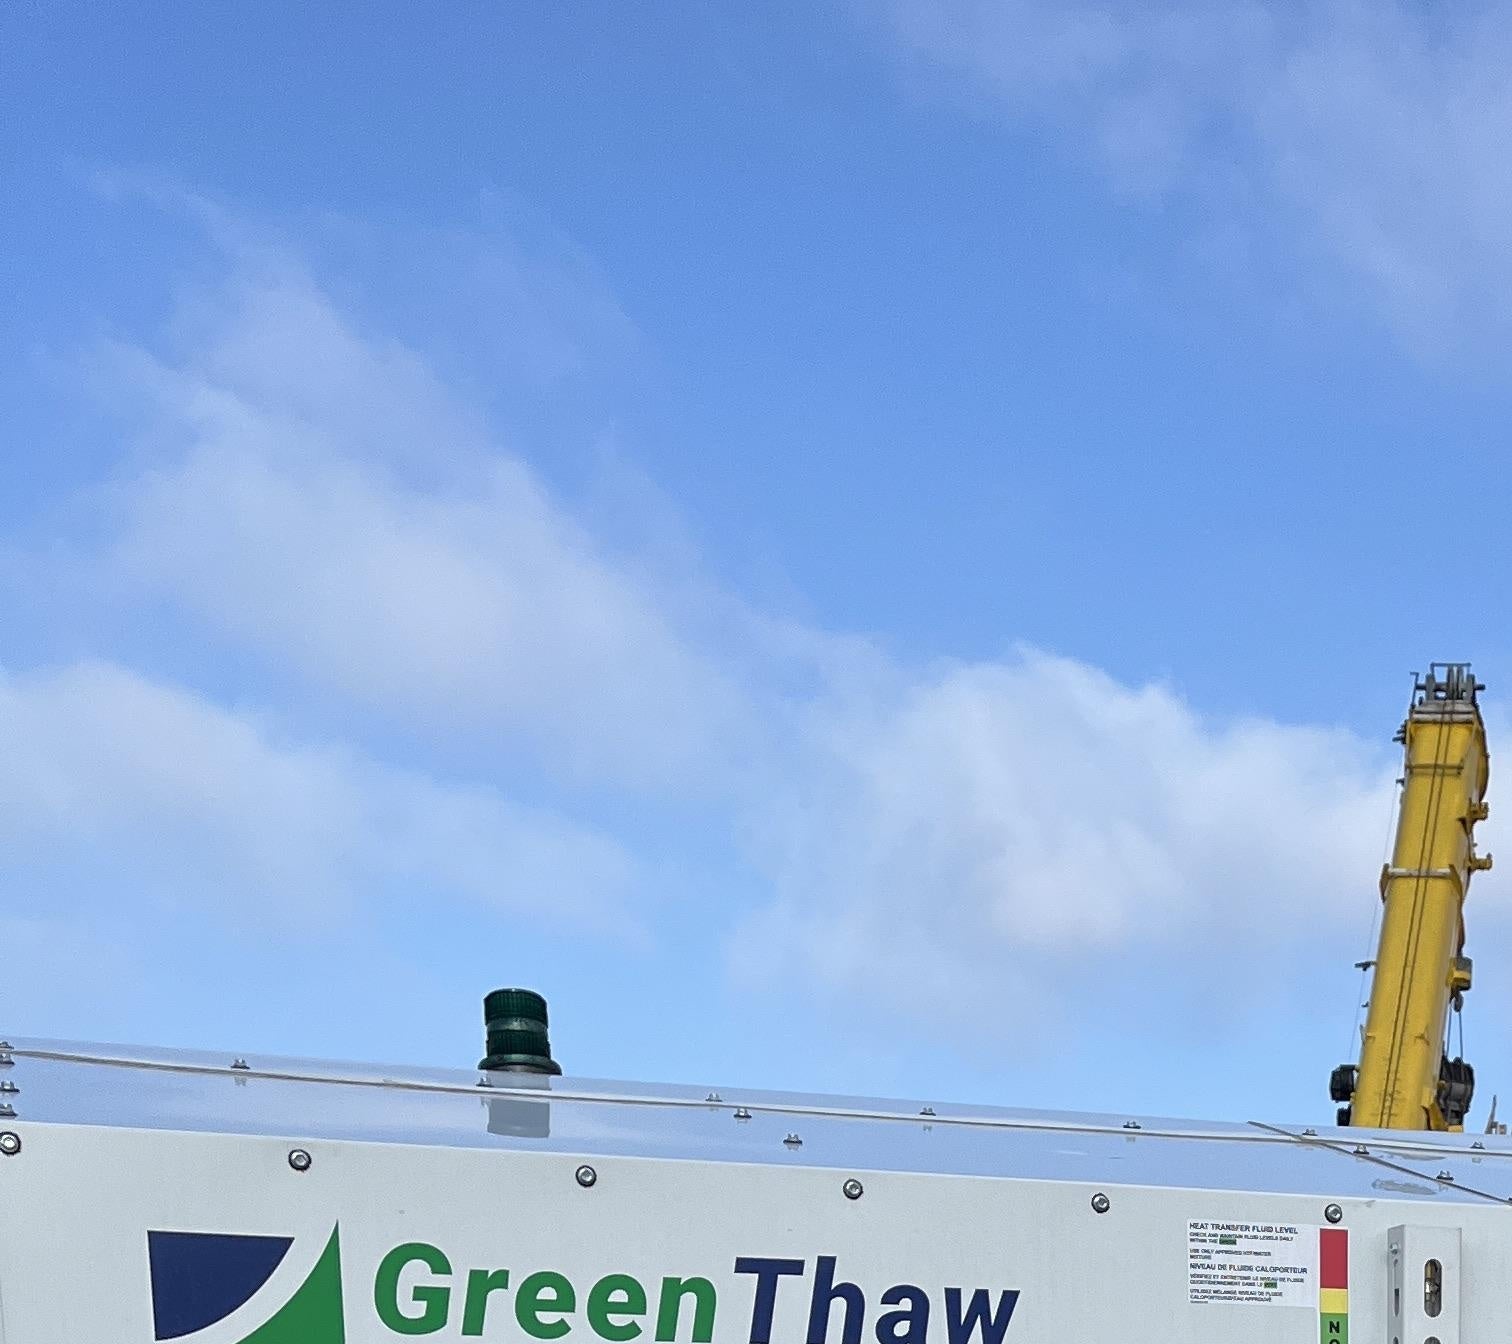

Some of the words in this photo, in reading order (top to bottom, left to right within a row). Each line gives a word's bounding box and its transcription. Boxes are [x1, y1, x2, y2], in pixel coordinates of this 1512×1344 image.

[1189, 1222, 1209, 1230] HEAT
[1211, 1223, 1250, 1232] TRANSFER
[1252, 1225, 1273, 1233] FLUID
[1275, 1226, 1298, 1235] LEVEL
